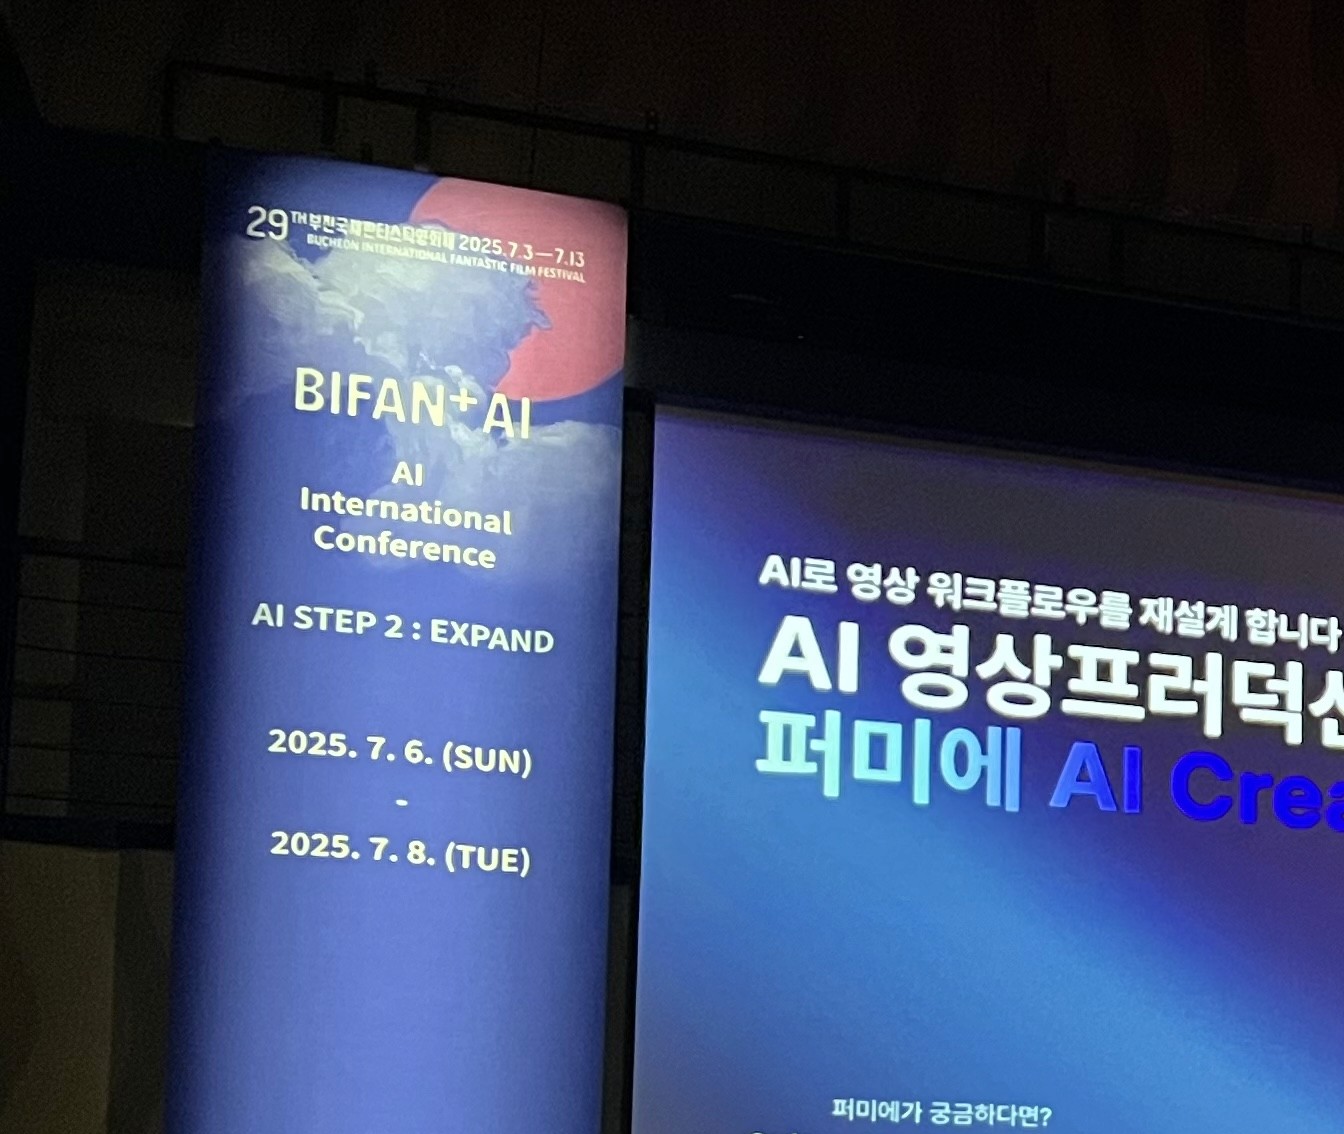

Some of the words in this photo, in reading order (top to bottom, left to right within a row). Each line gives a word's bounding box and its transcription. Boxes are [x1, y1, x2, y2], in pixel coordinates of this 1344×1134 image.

[307, 234, 359, 251] BUCHEON
[362, 242, 447, 263] INTERNATIONAL
[450, 254, 508, 272] FANTASTIC
[510, 263, 536, 276] FILM
[538, 267, 586, 283] FESTIVAL
[392, 462, 423, 486] AI
[300, 487, 512, 536] International
[313, 525, 497, 569] Conference
[252, 603, 283, 627] AI
[293, 605, 377, 634] STEP
[384, 615, 403, 639] 2
[430, 619, 555, 653] EXPAND
[758, 553, 837, 595] AI로
[846, 560, 920, 605] 영상
[927, 571, 1133, 630] 워크플로우를
[1139, 595, 1239, 643] 재설계
[1245, 606, 1342, 654] 합니다
[757, 613, 860, 694] AI
[267, 729, 357, 760] 2025.
[443, 741, 532, 779] (SUN)
[754, 708, 1021, 814] 퍼미에
[1049, 740, 1142, 814] AI
[270, 831, 360, 860] 2025.
[445, 841, 531, 878] (TUE)
[832, 1098, 923, 1124] 퍼미에가
[929, 1101, 1053, 1127] 궁금하다면?
